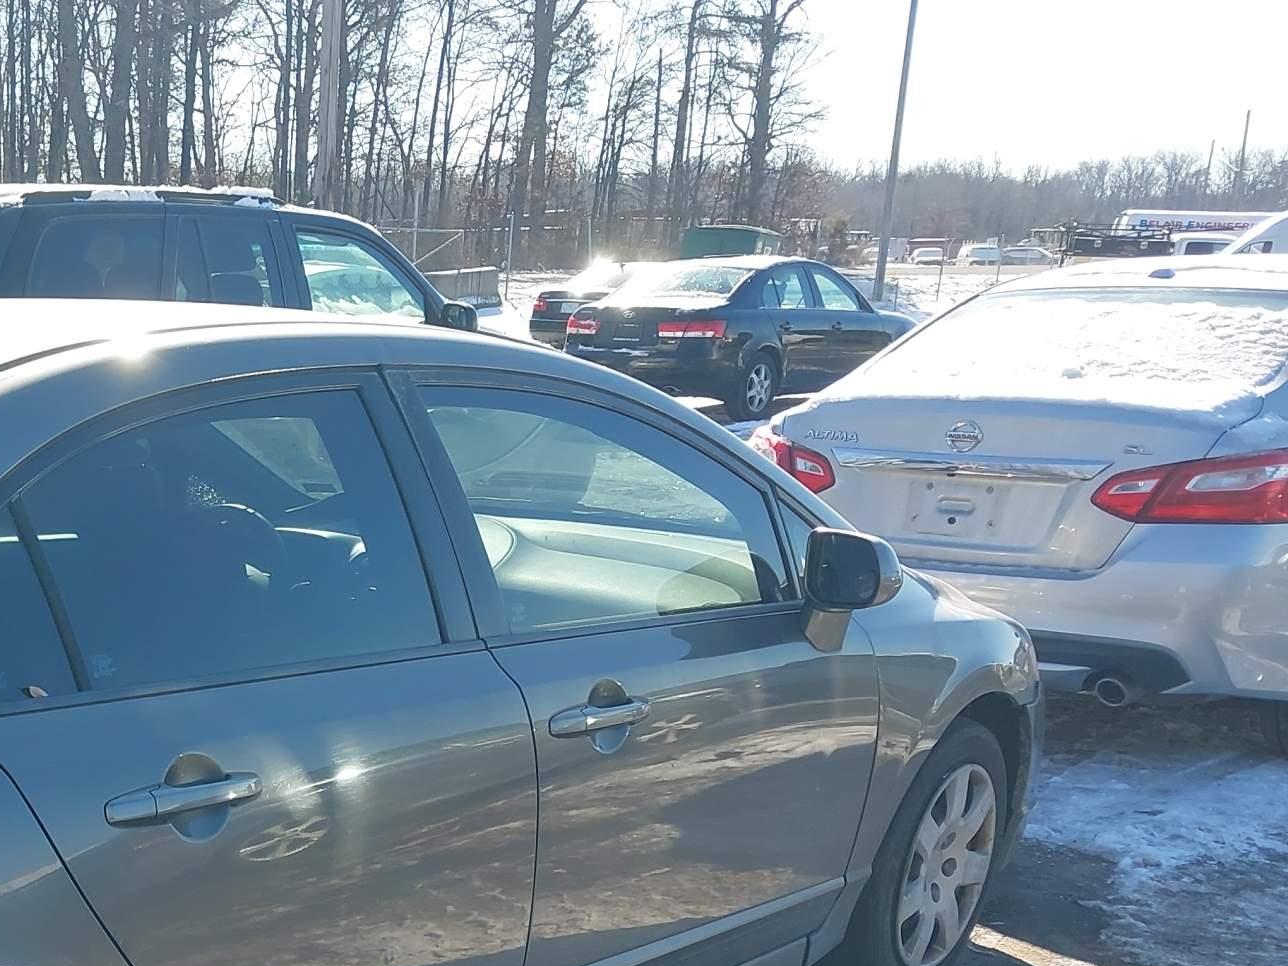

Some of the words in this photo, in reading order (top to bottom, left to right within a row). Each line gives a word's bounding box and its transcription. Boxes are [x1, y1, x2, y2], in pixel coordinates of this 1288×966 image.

[1187, 220, 1258, 230] ENGINEERI
[804, 429, 859, 443] ALTIMA
[948, 432, 979, 441] NISSAN
[1123, 444, 1153, 456] SL
